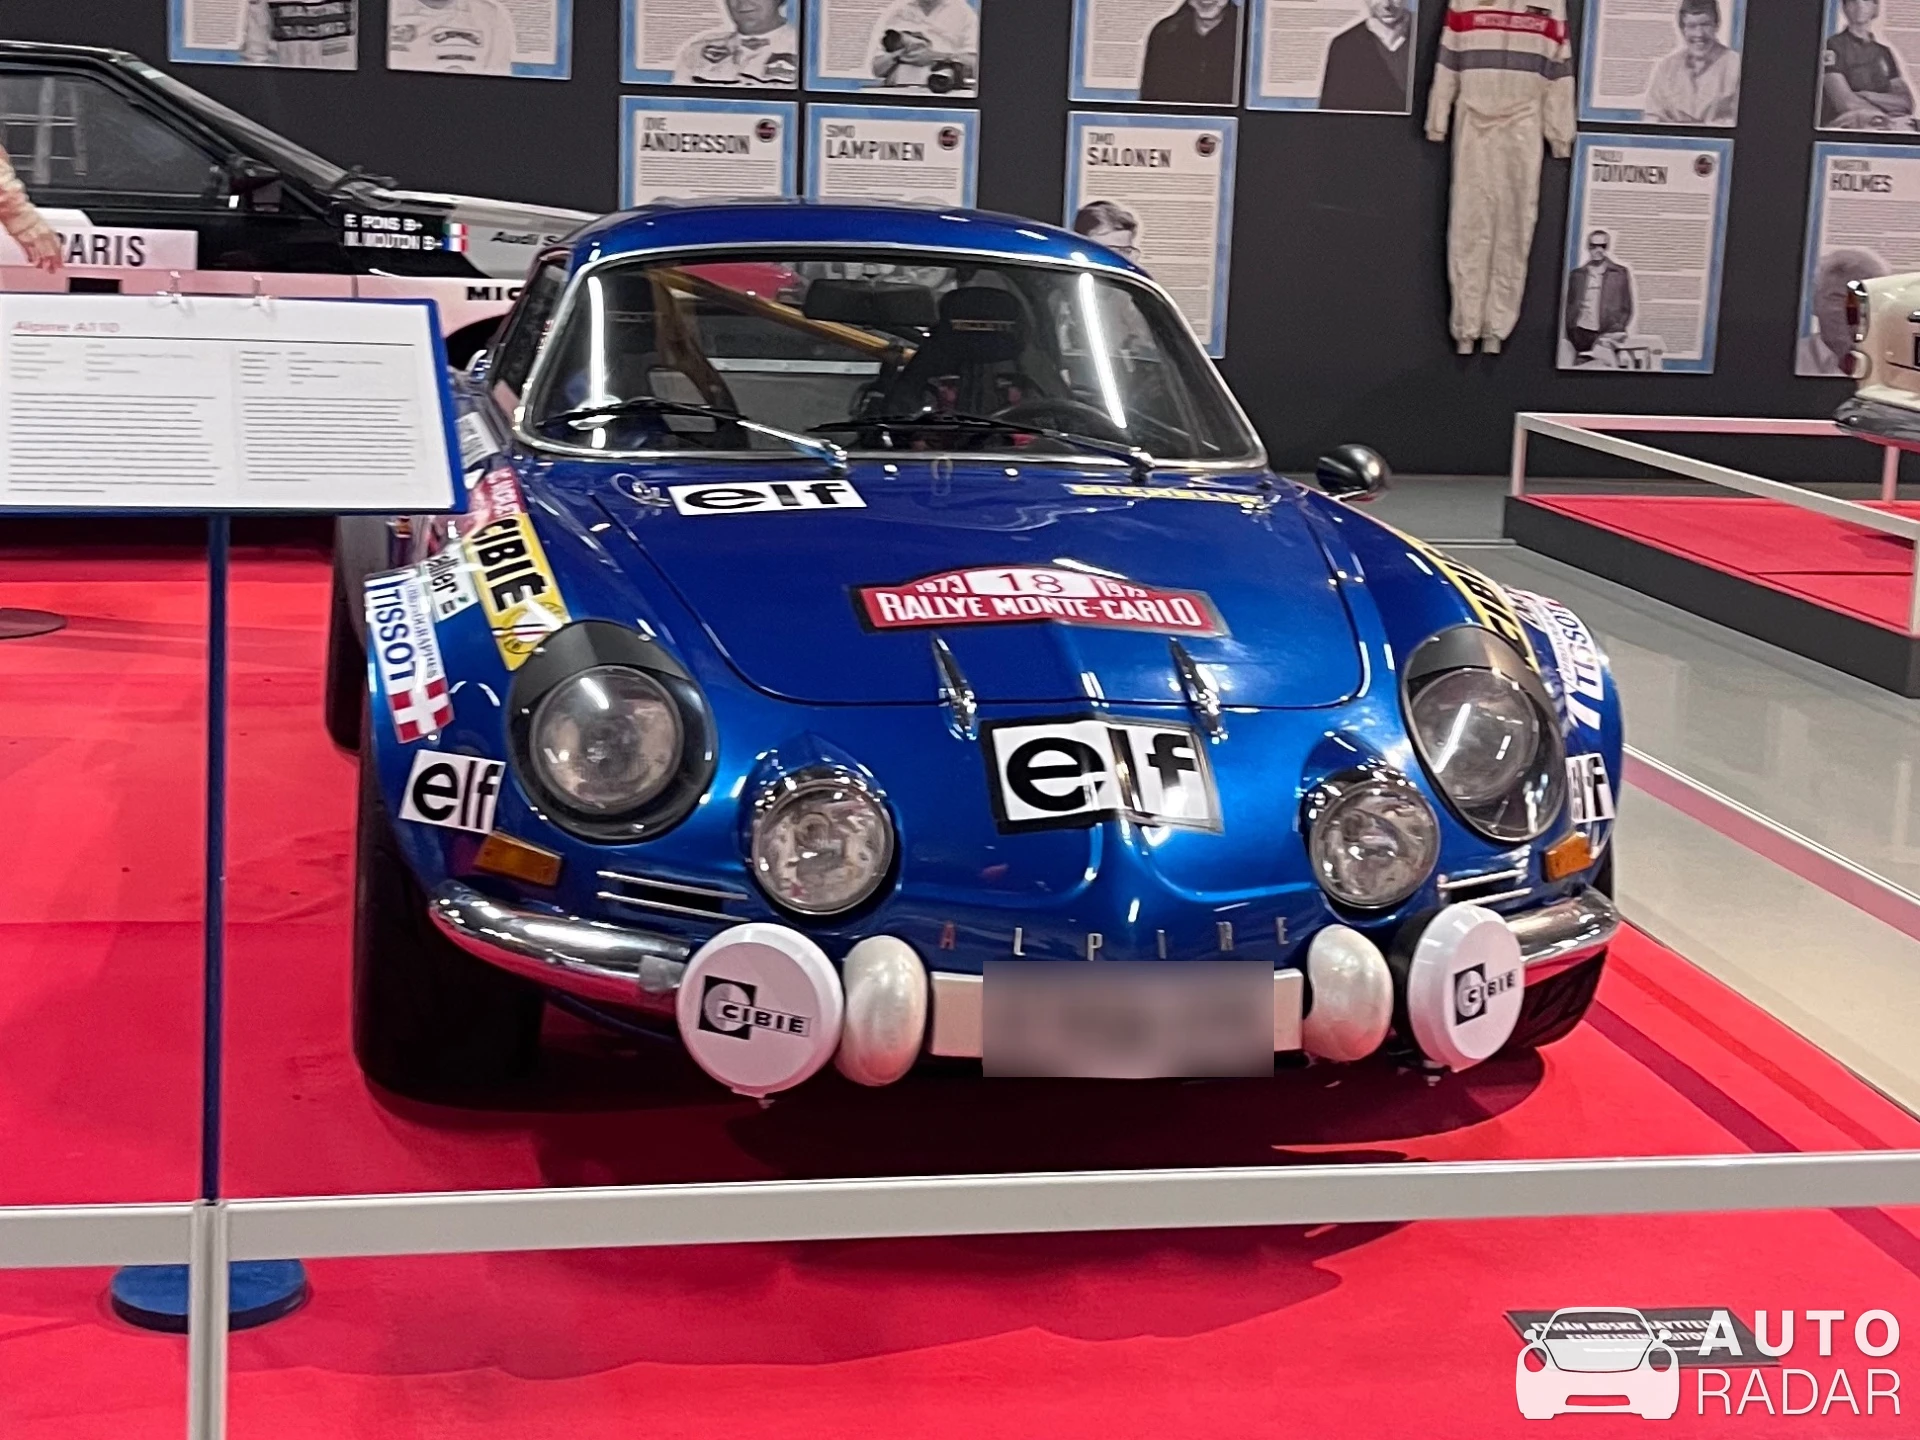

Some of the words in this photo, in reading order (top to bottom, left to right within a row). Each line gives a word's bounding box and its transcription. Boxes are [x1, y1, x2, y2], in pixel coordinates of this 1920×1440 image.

[640, 132, 750, 155] ANDERSSON
[826, 139, 925, 161] LAMPINEN
[1087, 147, 1171, 168] SALONEN
[1830, 174, 1892, 193] HOLMES
[490, 231, 539, 246] Audi
[684, 483, 847, 510] elf
[915, 574, 968, 595] 1973
[999, 572, 1063, 594] 18
[1100, 581, 1148, 599] 1973
[876, 592, 990, 622] RALLYE
[990, 596, 1202, 627] MONTE-CARLO
[371, 588, 417, 682] TISSOT
[1007, 727, 1197, 813] elf
[413, 760, 501, 830] elf
